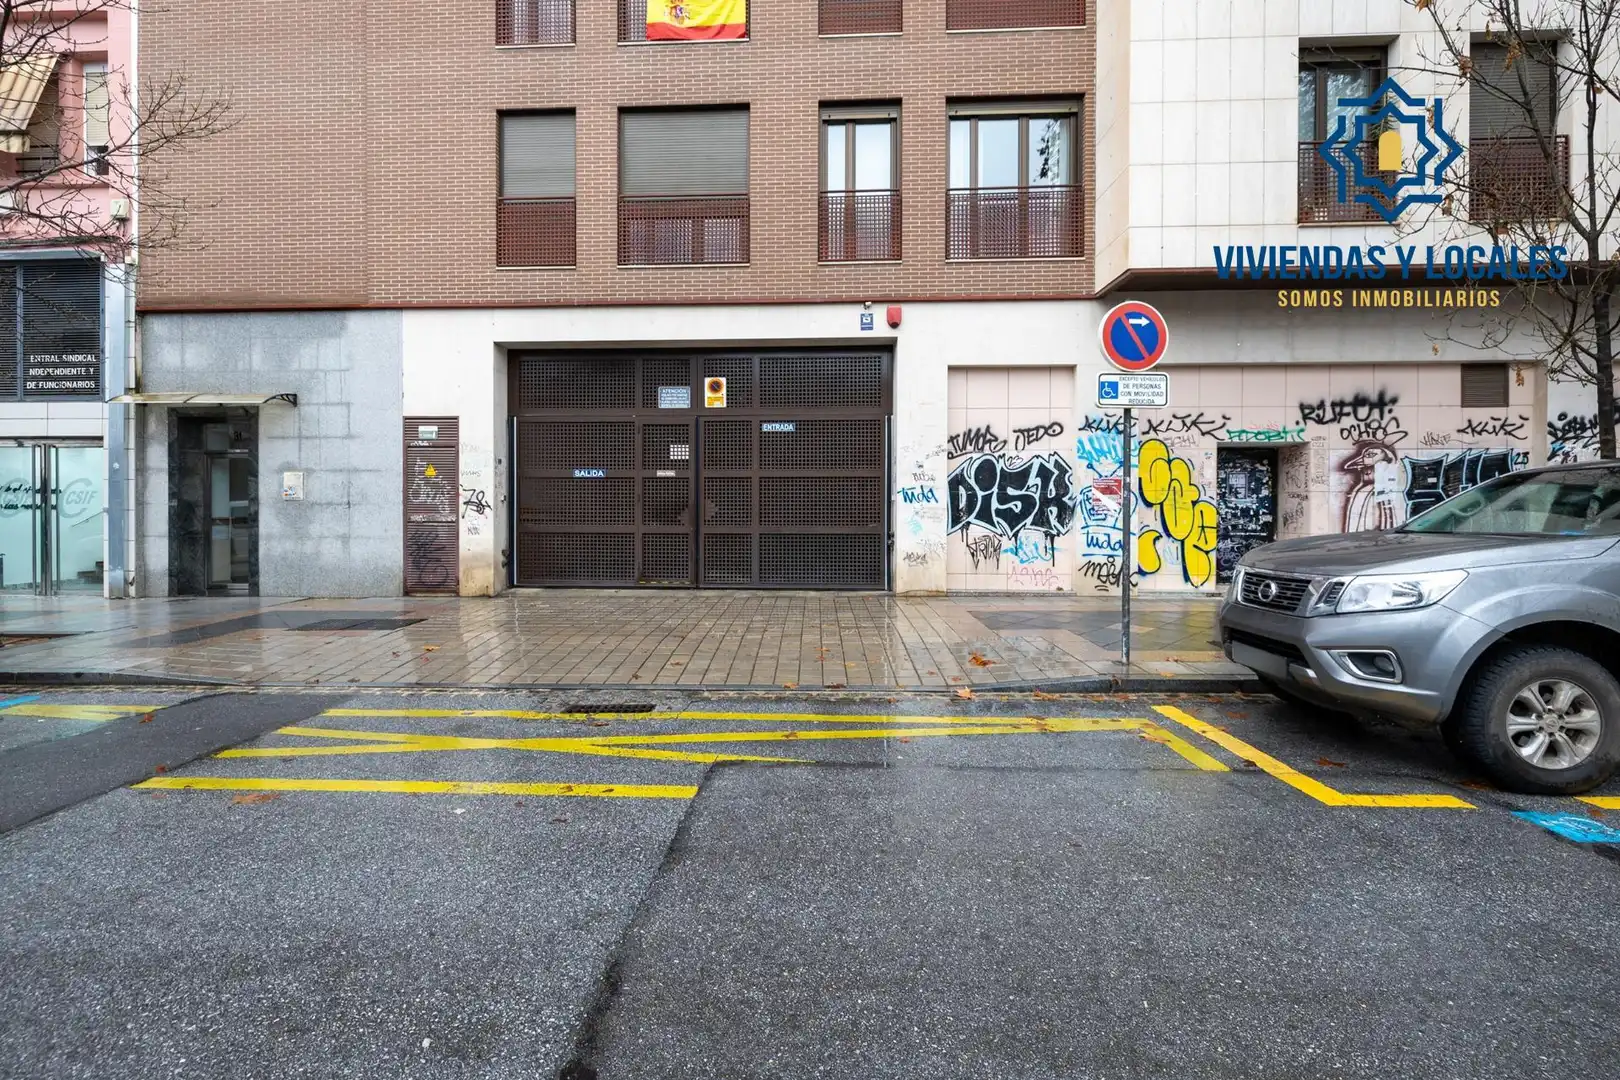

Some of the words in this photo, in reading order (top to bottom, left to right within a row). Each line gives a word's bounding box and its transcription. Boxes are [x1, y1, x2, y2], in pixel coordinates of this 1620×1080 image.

[62, 354, 96, 362] SINDICAL
[26, 381, 37, 389] DE
[39, 381, 95, 389] FUNCIONARIOS
